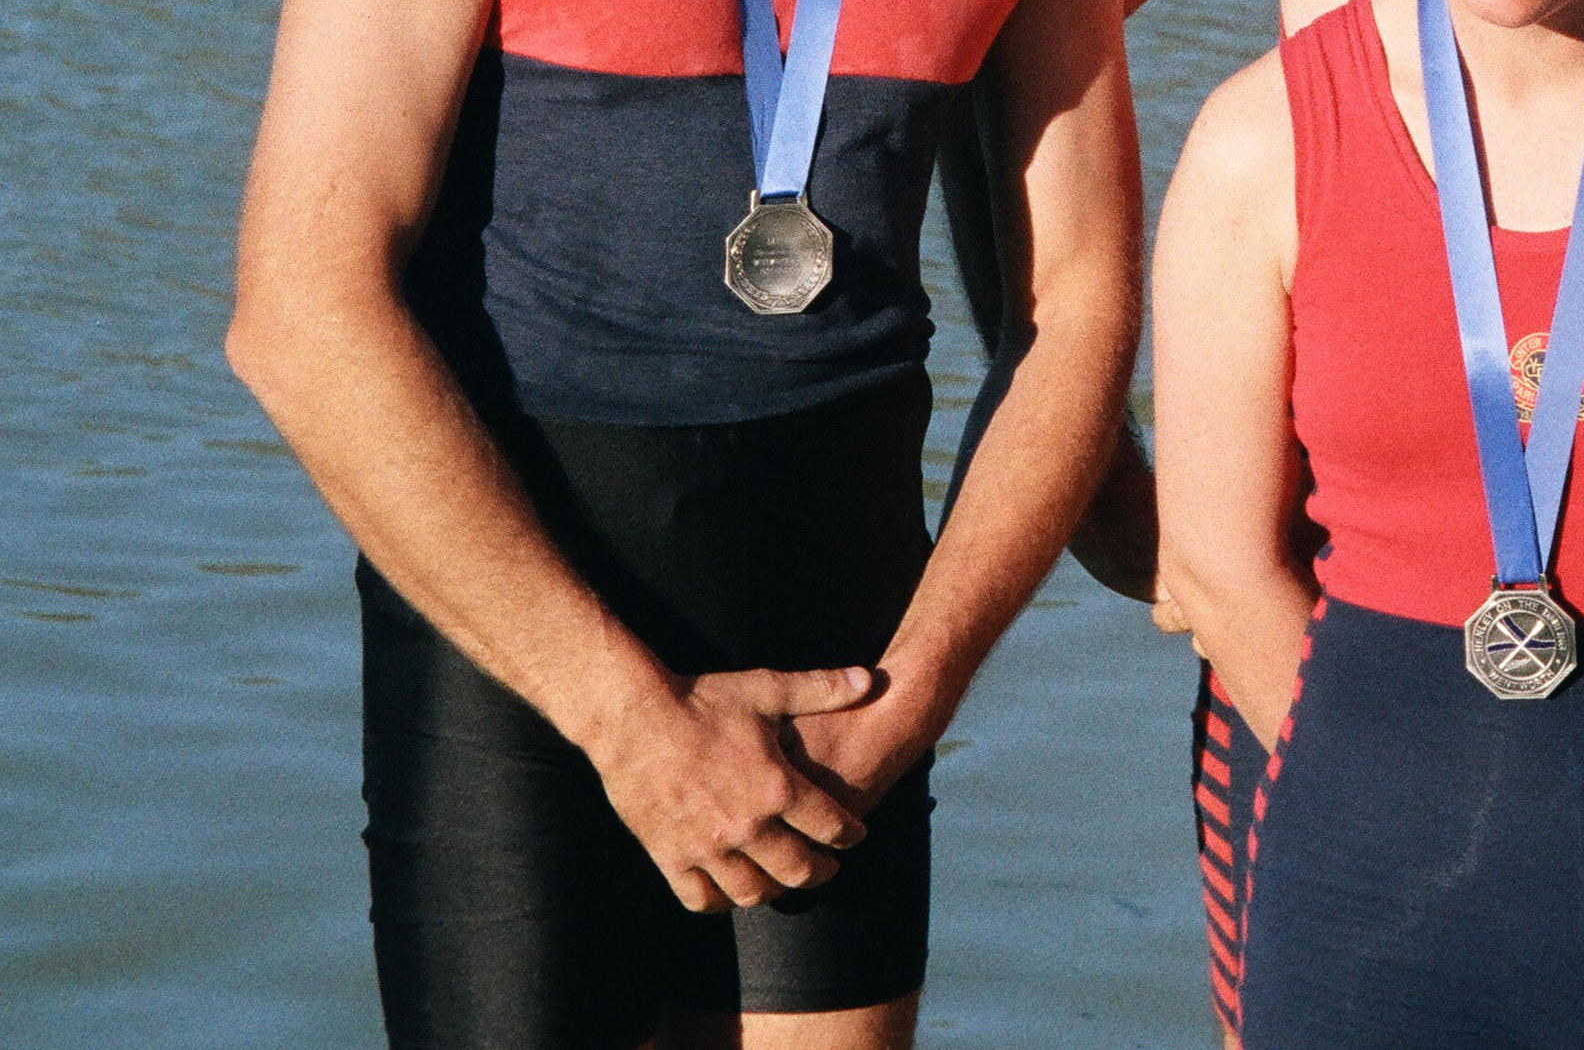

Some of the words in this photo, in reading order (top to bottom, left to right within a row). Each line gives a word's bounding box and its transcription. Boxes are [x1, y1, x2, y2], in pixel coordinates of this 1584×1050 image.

[1474, 611, 1495, 652] HENLEY
[1496, 601, 1513, 613] ON
[1518, 599, 1540, 612] THE
